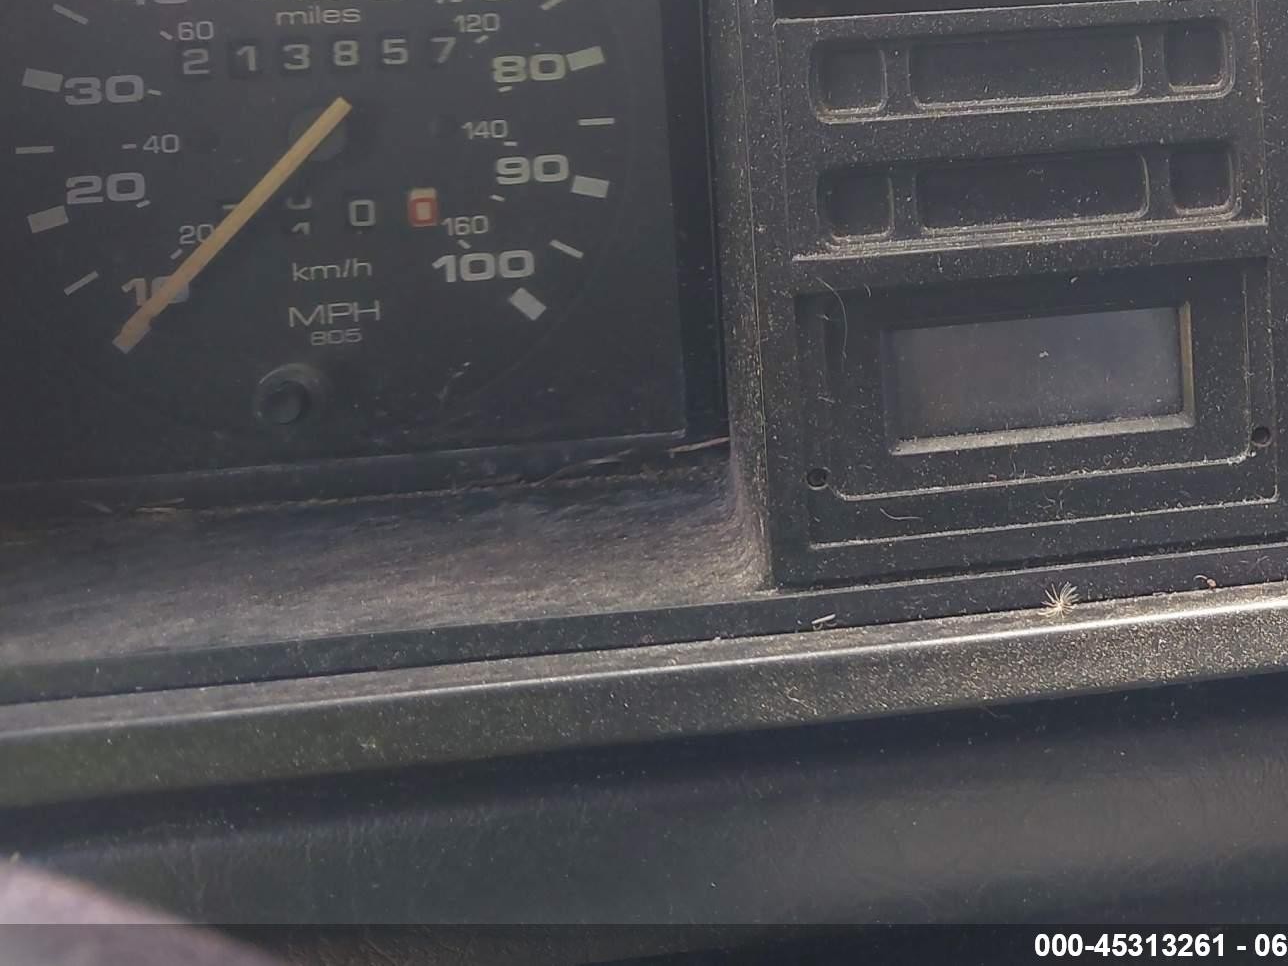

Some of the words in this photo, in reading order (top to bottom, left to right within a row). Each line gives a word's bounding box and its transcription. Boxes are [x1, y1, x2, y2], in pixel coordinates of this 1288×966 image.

[275, 6, 362, 25] miles
[453, 13, 500, 33] 120
[177, 21, 215, 41] 60
[492, 53, 566, 83] 80
[64, 74, 145, 106] 30
[462, 119, 509, 139] 140
[142, 134, 181, 154] 40
[495, 154, 570, 185] 90
[65, 172, 147, 205] 20
[441, 215, 490, 236] 160
[291, 258, 373, 282] km/h
[432, 249, 535, 283] 100
[288, 300, 381, 328] MPH
